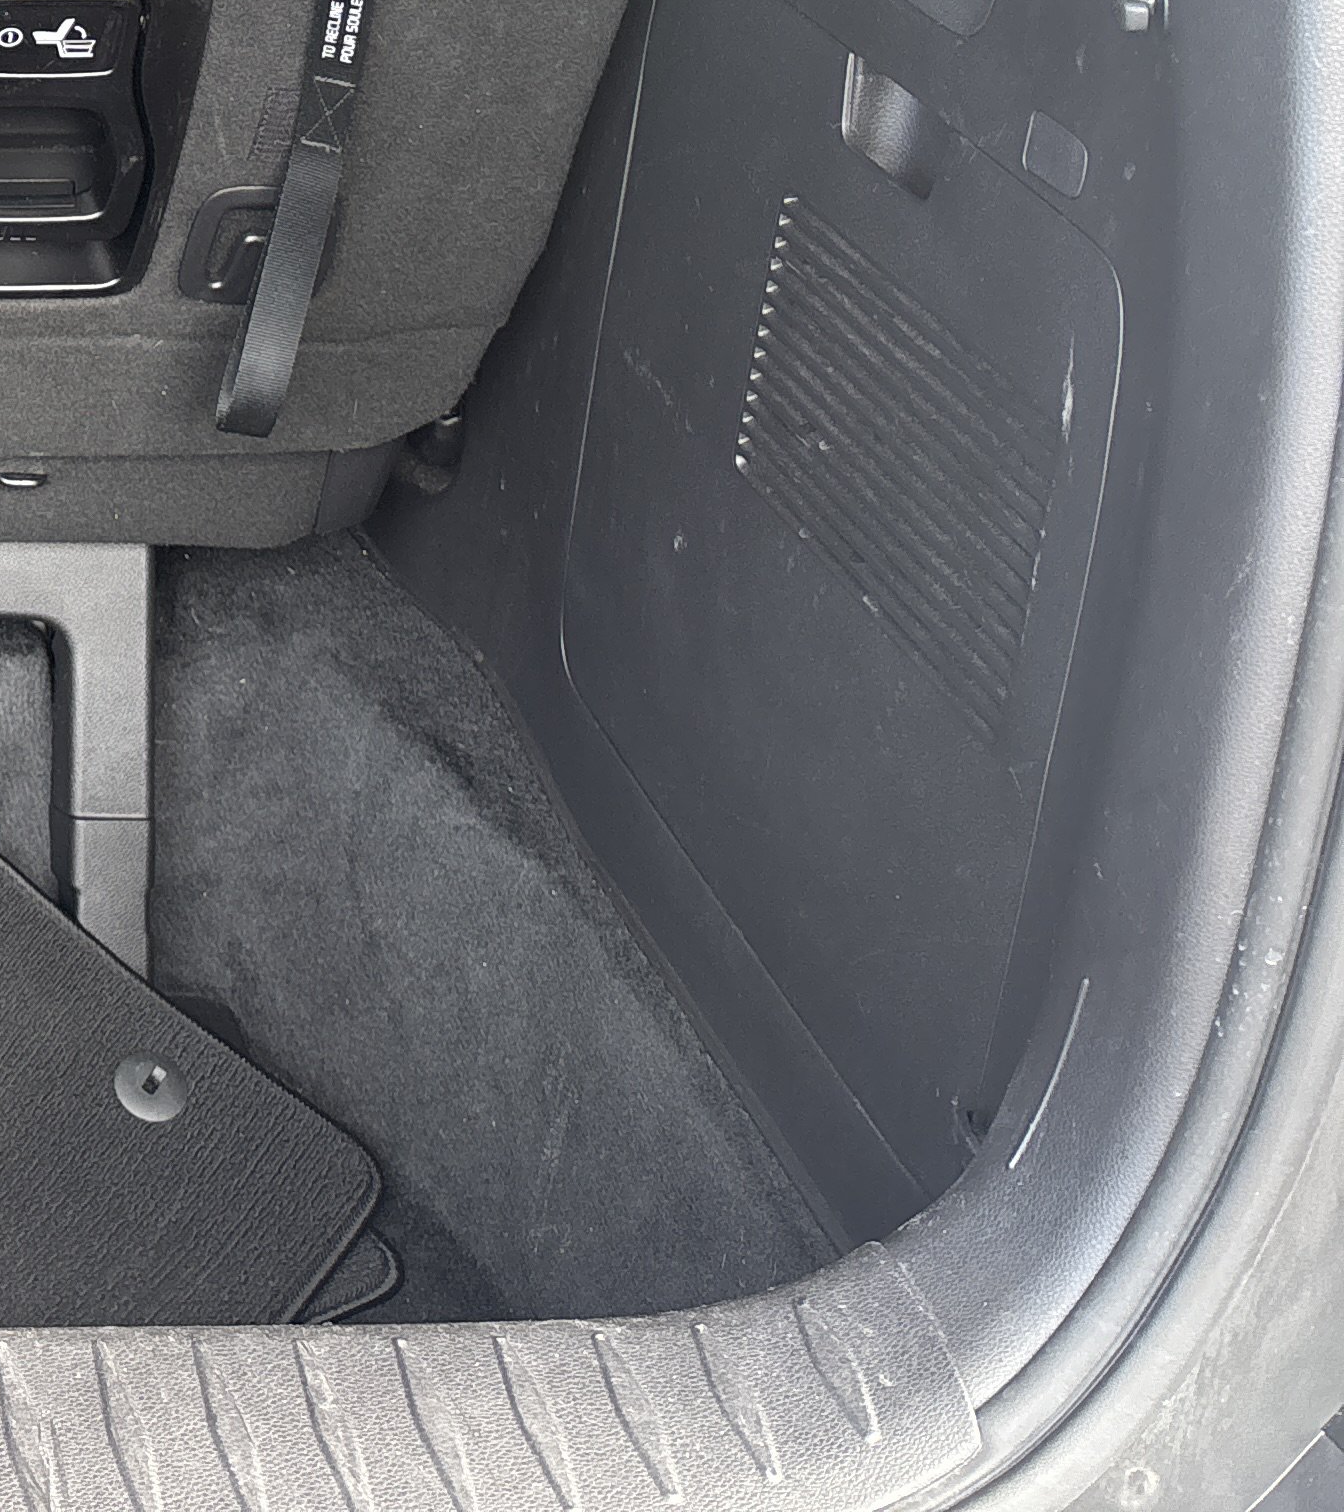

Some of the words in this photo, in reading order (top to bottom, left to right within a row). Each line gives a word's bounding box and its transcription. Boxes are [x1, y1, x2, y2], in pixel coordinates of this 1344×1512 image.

[324, 0, 345, 44] RECLINE
[321, 44, 337, 59] TO
[339, 33, 357, 64] POUR
